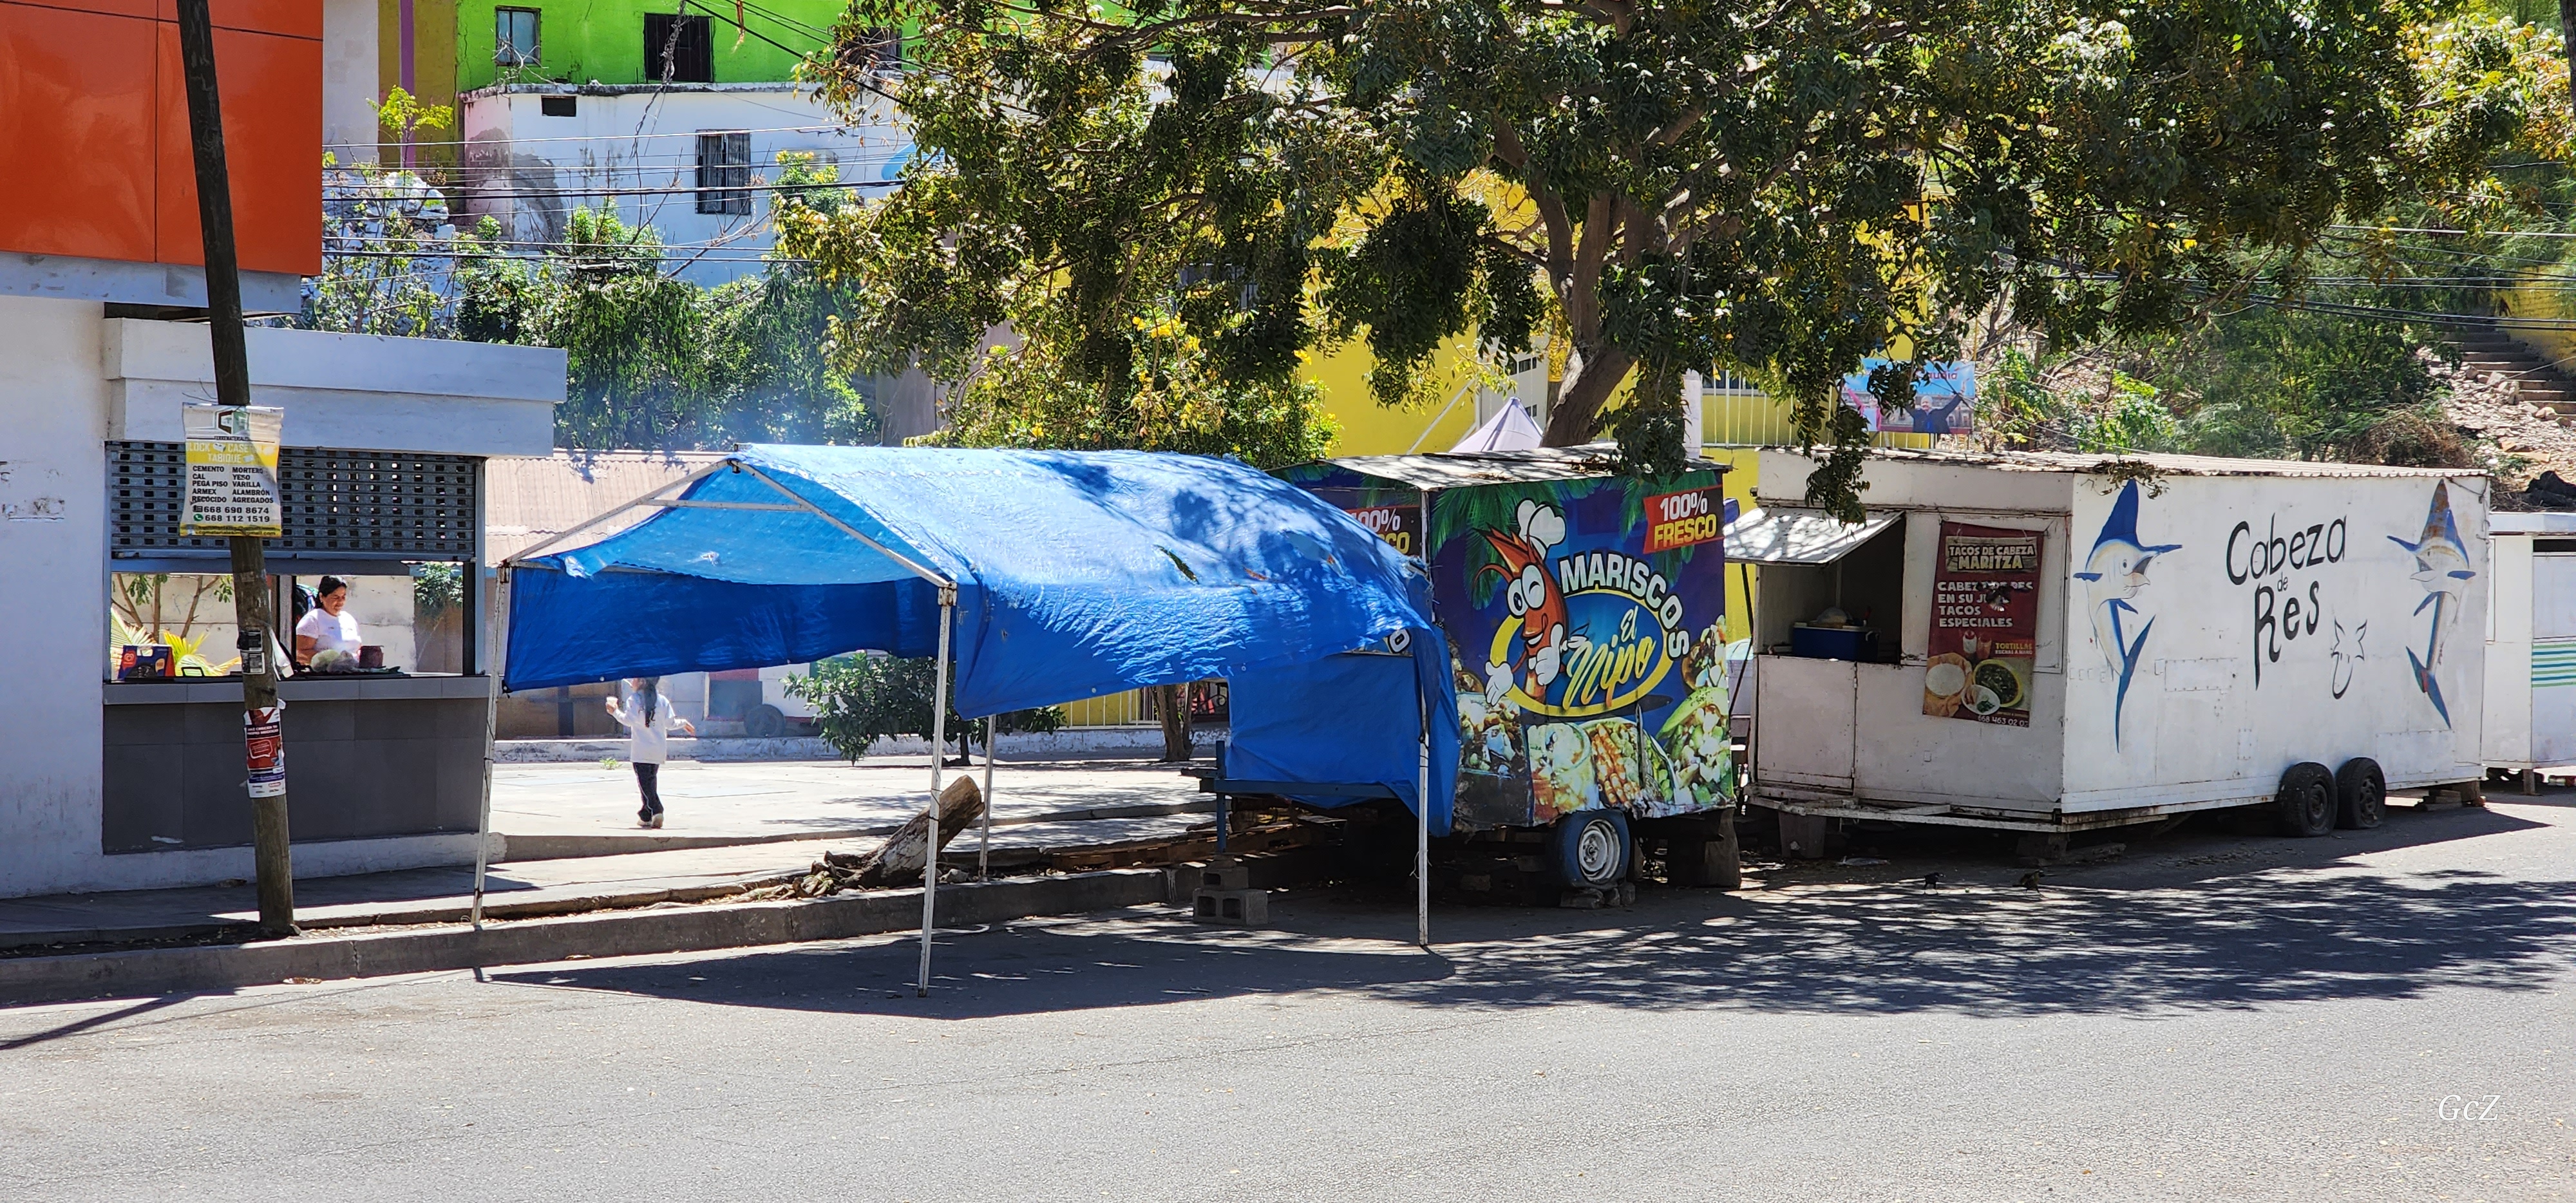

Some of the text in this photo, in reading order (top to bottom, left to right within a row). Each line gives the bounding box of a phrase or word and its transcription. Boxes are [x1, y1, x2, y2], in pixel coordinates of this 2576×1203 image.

[208, 453, 242, 463] TABIQUE
[1660, 490, 1708, 522] 100%
[1351, 508, 1401, 533] 00%
[1654, 514, 1717, 549] FRESCO
[1949, 546, 2034, 556] TACOS DE CABEZA
[2226, 513, 2347, 585] Cabeza
[1958, 555, 2023, 569] MARITZA
[2277, 572, 2288, 592] de
[1558, 552, 1690, 659] MARISCOS
[1938, 594, 1955, 603] EN
[1958, 594, 1973, 603] SU
[1938, 606, 1981, 616] TACOS
[1620, 605, 1638, 642] El
[1939, 618, 2013, 627] ESPECIALES
[2255, 580, 2320, 691] Res
[1563, 636, 1656, 710] Nipo
[1992, 716, 2006, 725] 463
